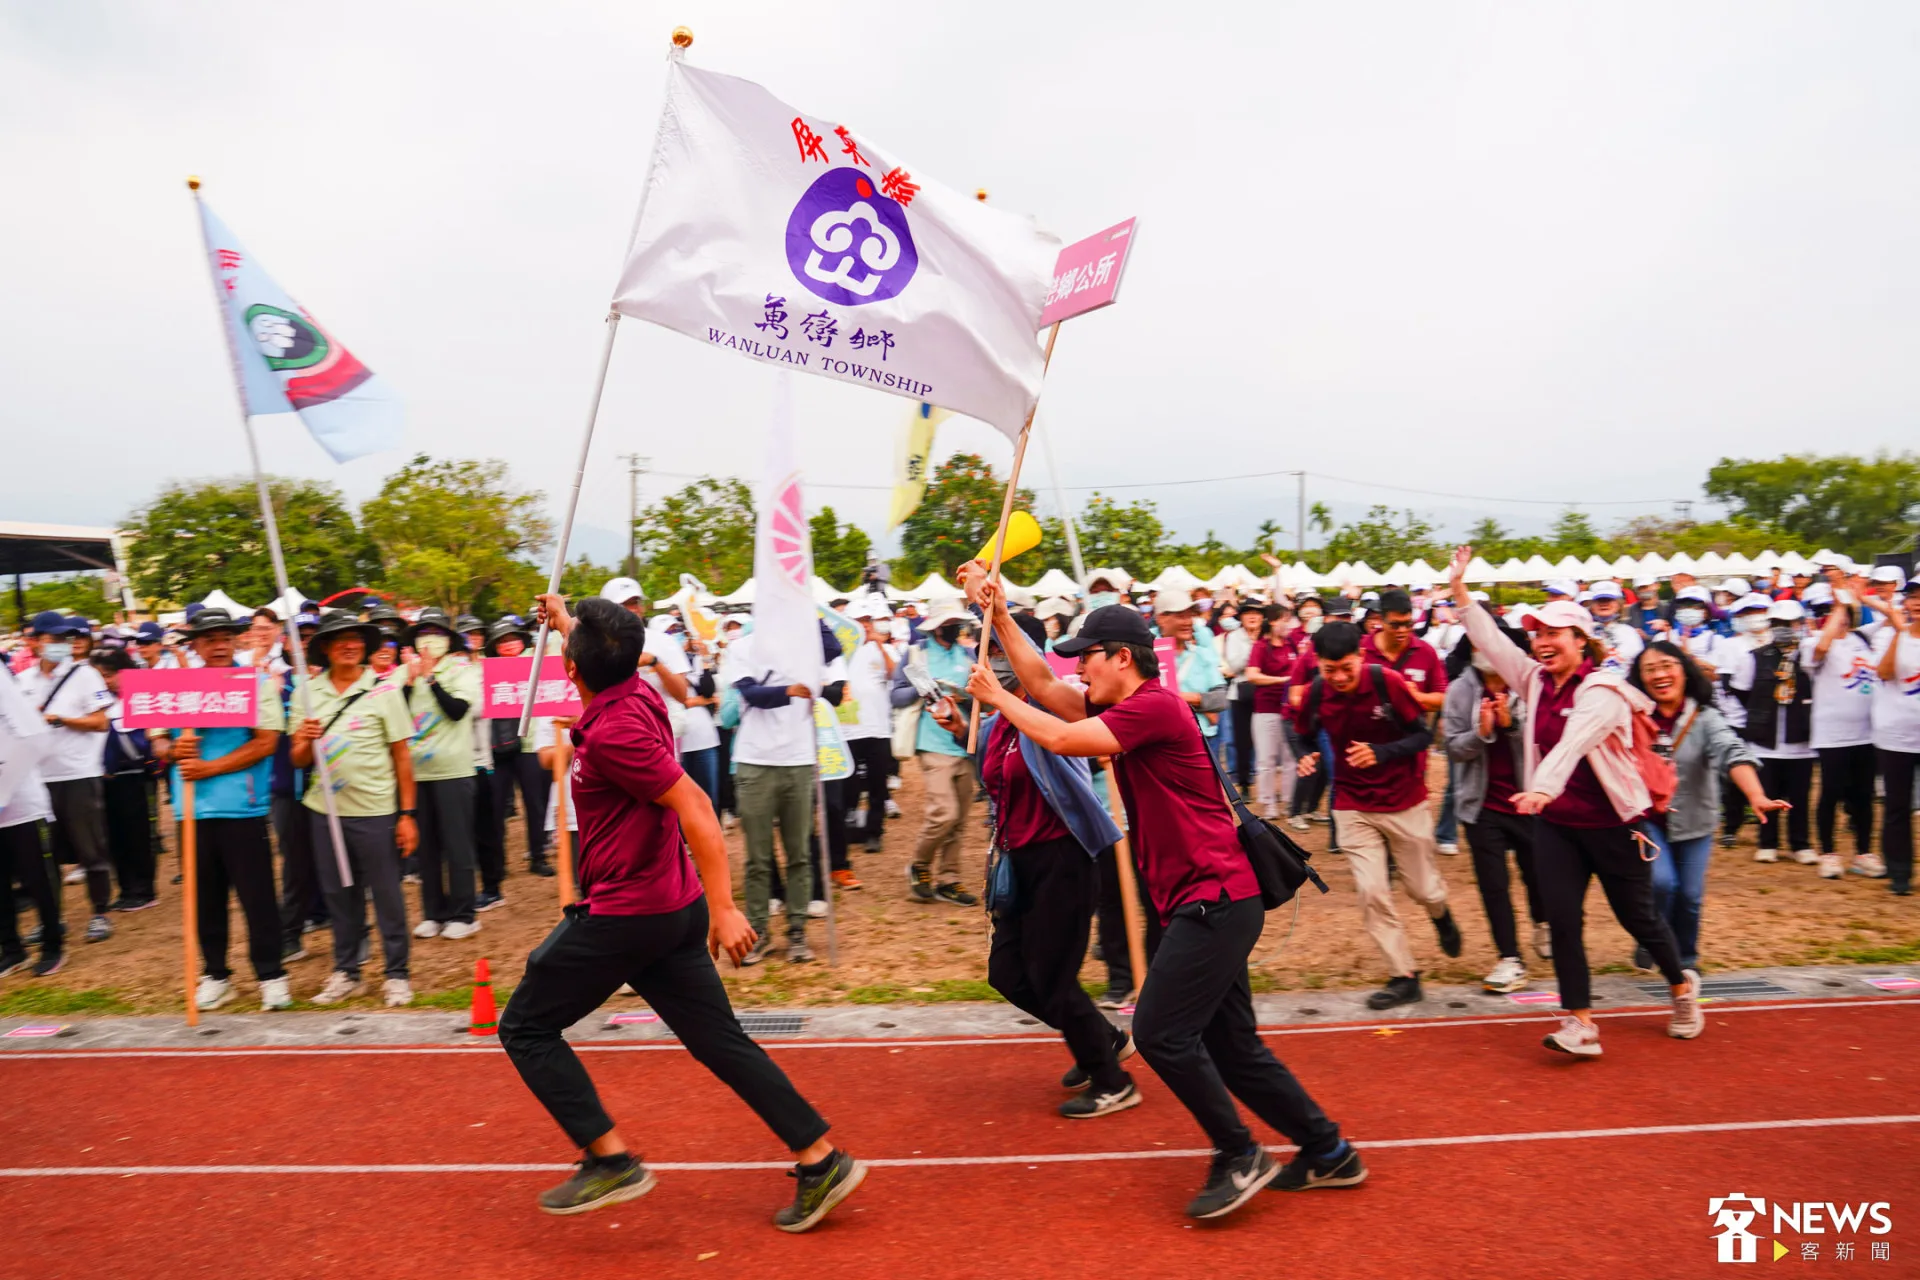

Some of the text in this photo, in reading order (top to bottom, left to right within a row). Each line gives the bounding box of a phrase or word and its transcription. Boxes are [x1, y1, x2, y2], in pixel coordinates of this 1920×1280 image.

[754, 292, 896, 361] 萬巒鄉
[708, 327, 933, 397] WANLUAN TOWNSHIP
